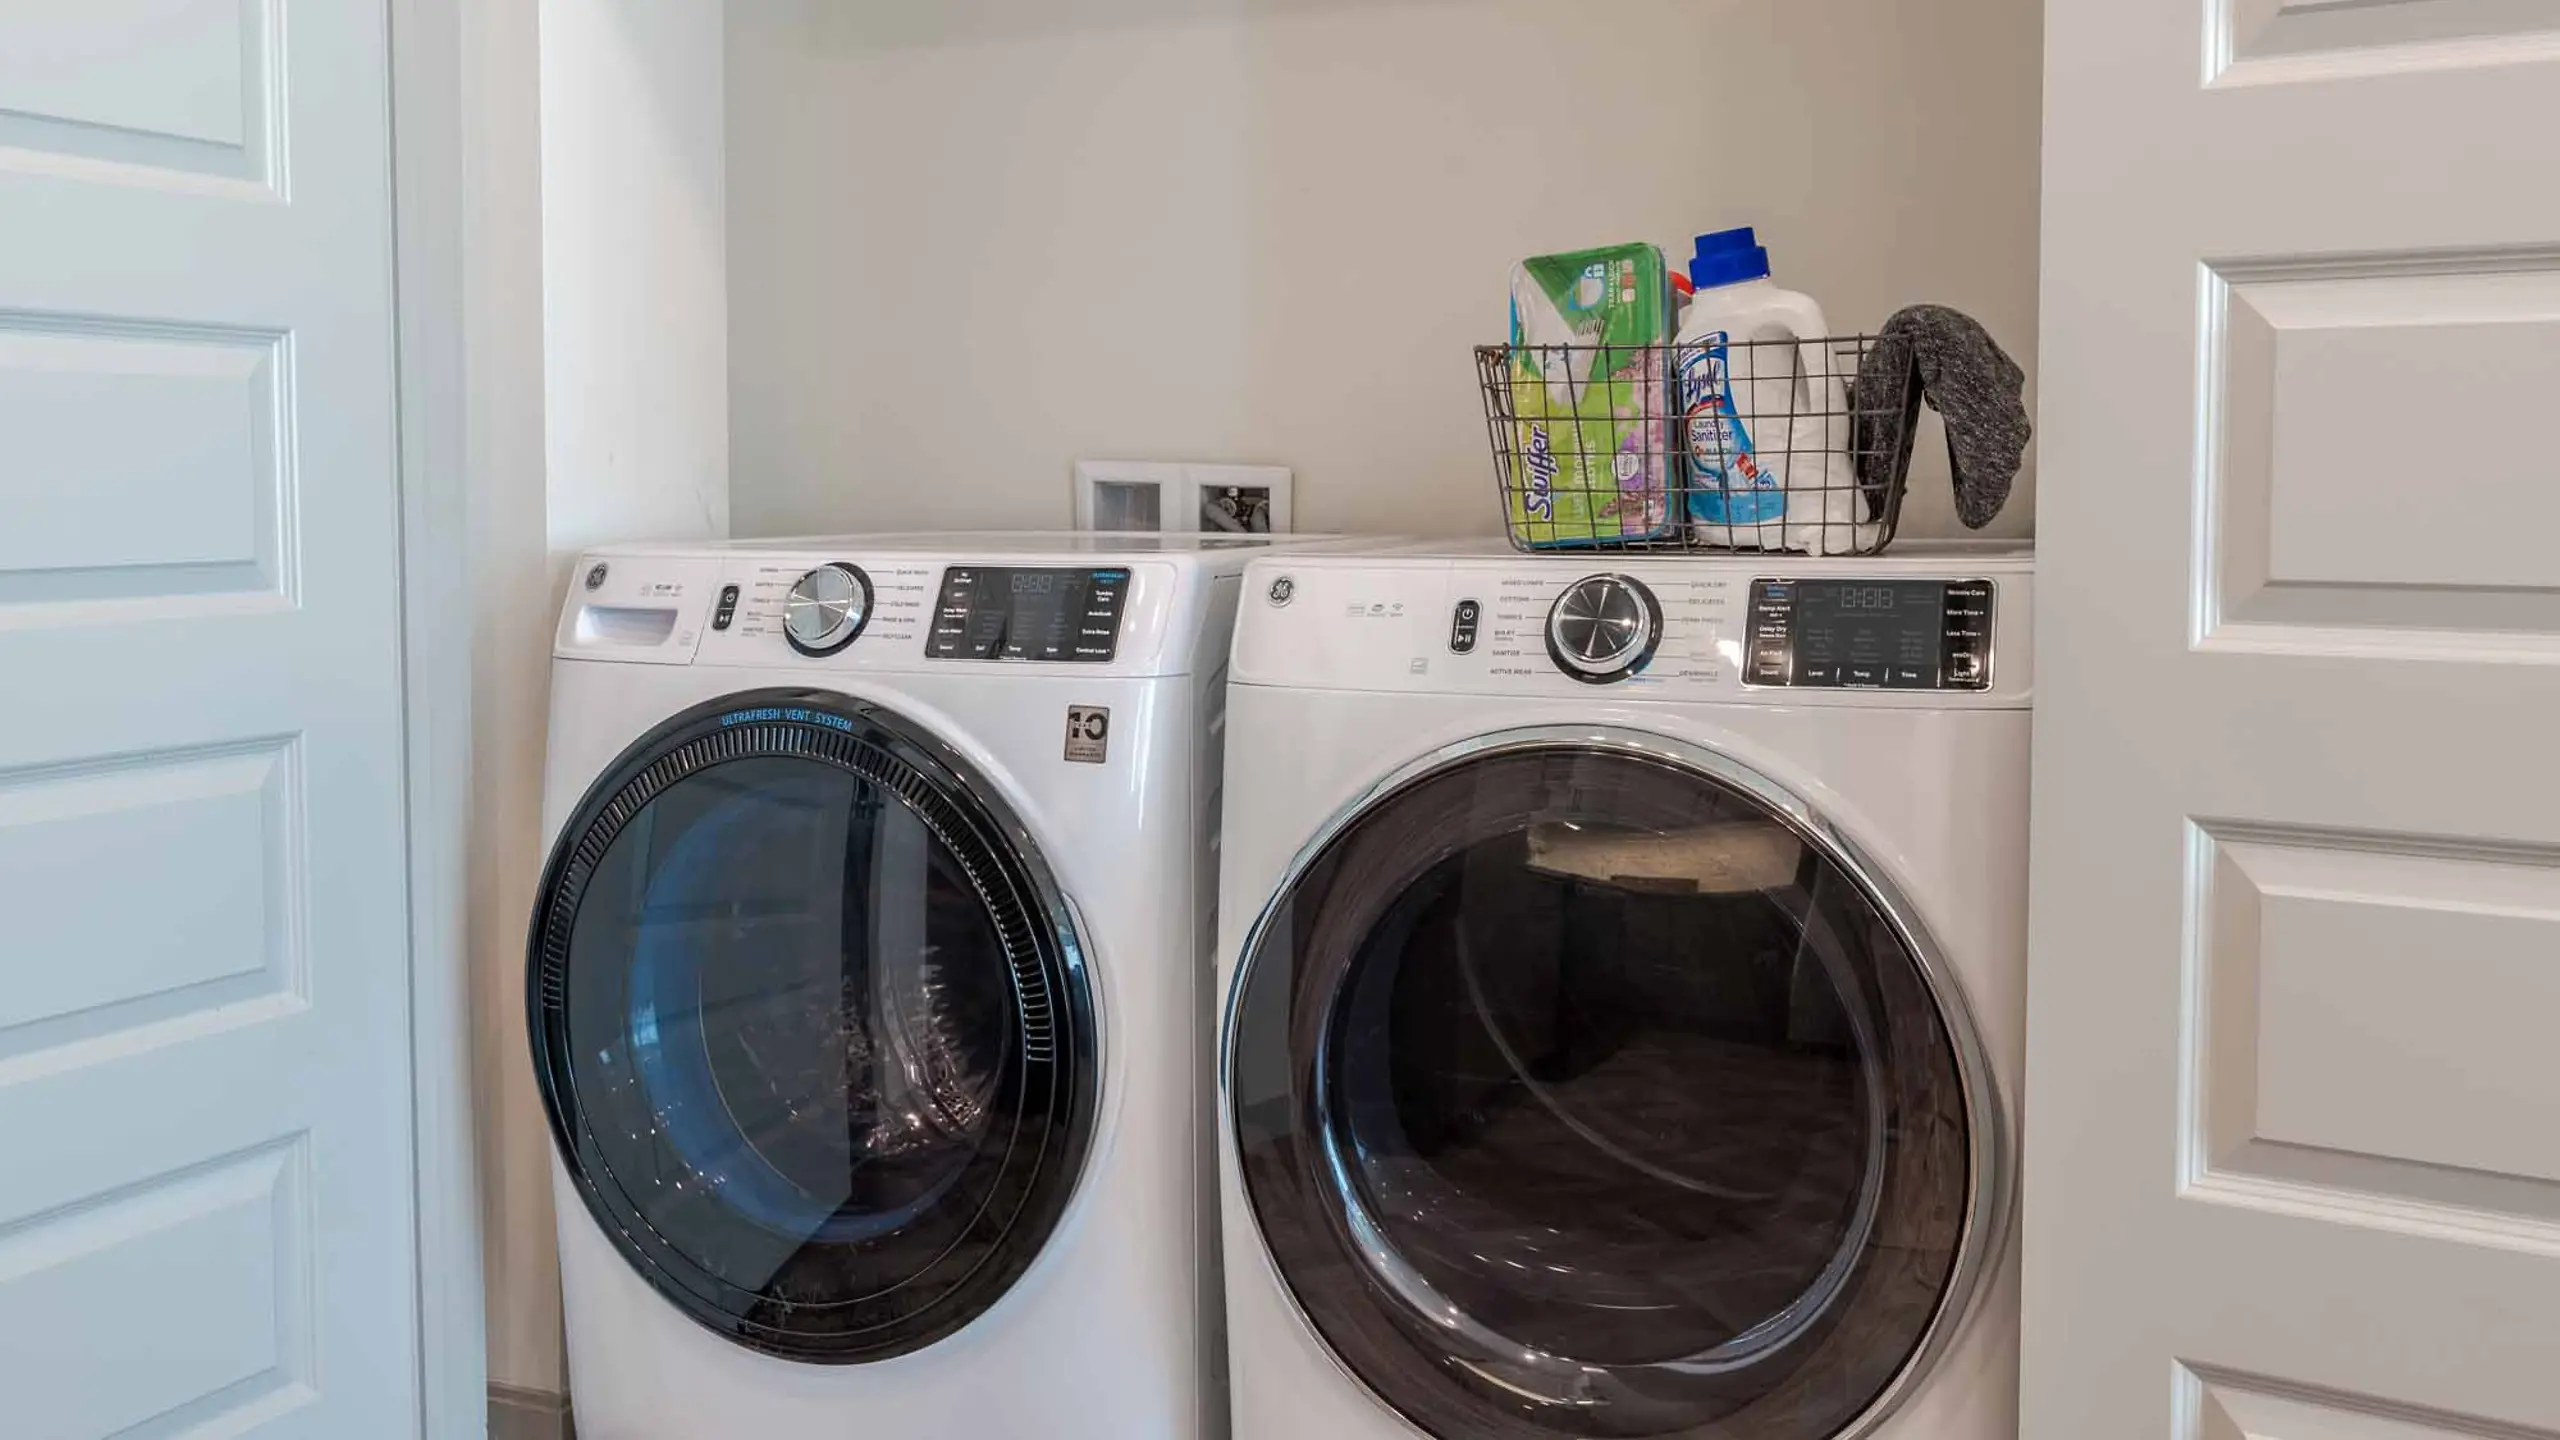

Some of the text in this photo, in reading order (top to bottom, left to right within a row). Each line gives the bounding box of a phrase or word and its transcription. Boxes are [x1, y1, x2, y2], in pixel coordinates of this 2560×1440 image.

[1693, 420, 1724, 430] Laundy
[1525, 425, 1559, 520] Swiffer
[721, 708, 853, 731] ULTRAFRESH VENT SYSTEM
[1069, 712, 1108, 740] 10
